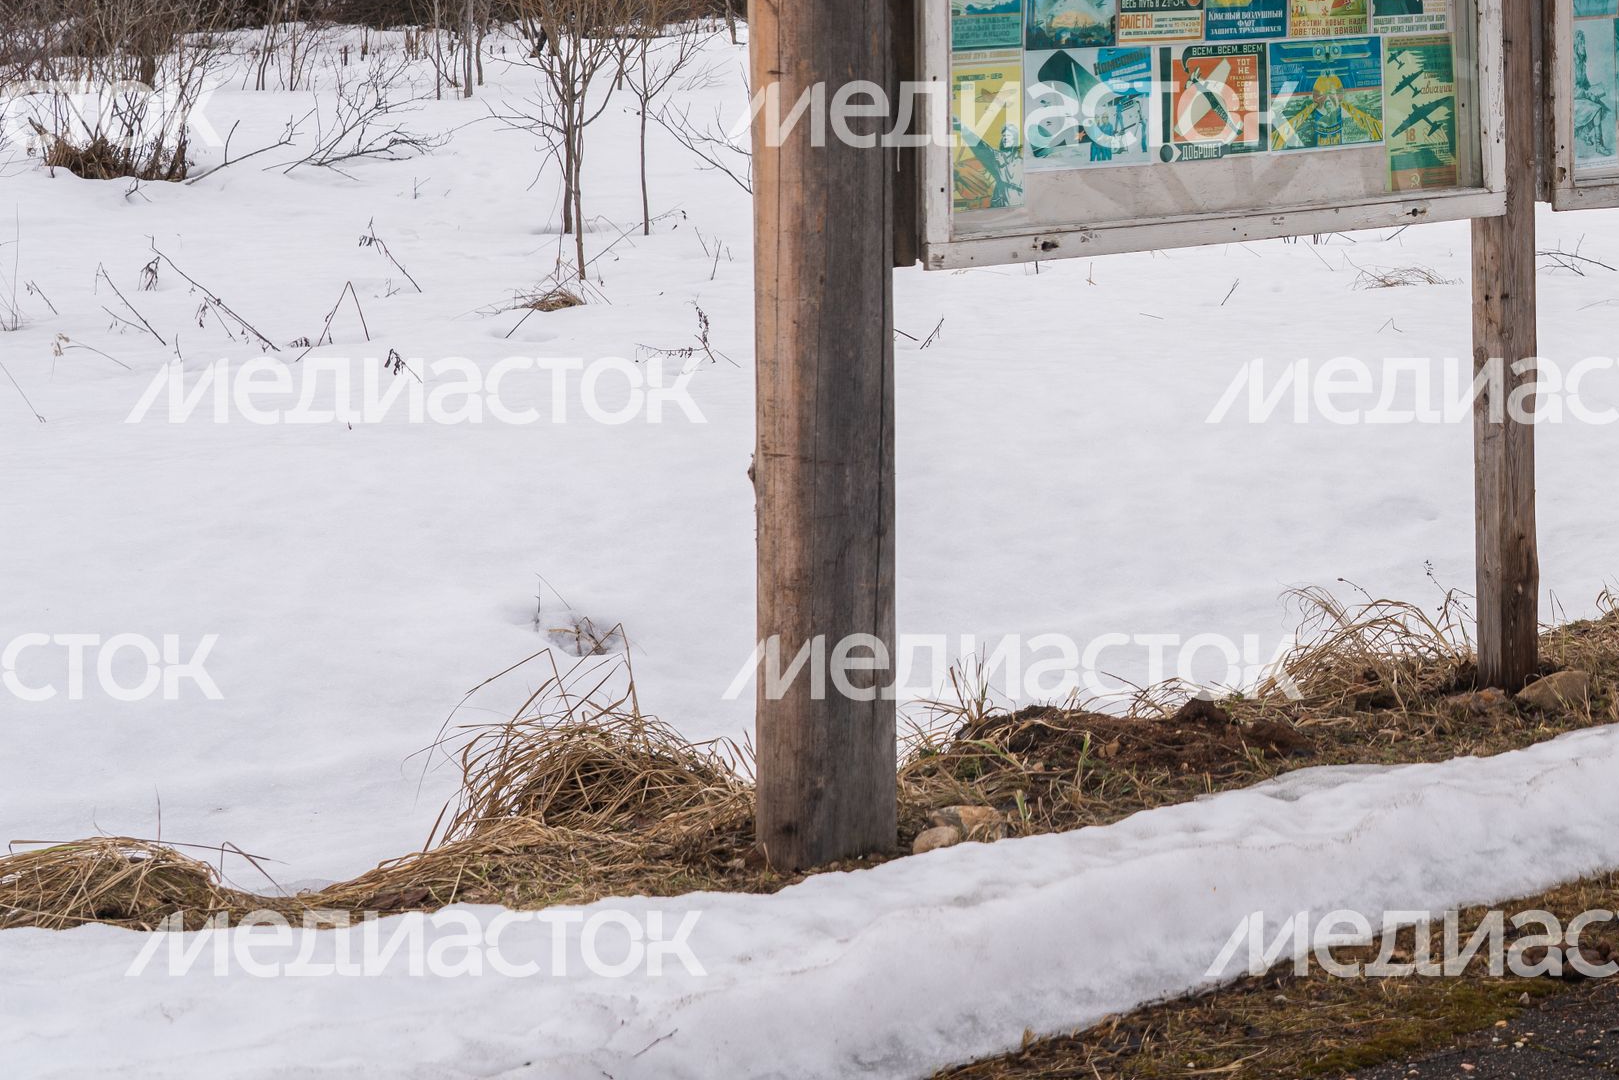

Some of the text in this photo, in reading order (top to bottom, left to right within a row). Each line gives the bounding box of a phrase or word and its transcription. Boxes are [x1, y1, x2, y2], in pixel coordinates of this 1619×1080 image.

[1121, 0, 1137, 9] ВЕСЬ
[1138, 0, 1154, 8] ПУТЬ
[1120, 14, 1153, 29] БИЛЕТЫ
[1236, 58, 1251, 66] ТОТ
[1182, 143, 1222, 160] ДОБРОЛЕТ
